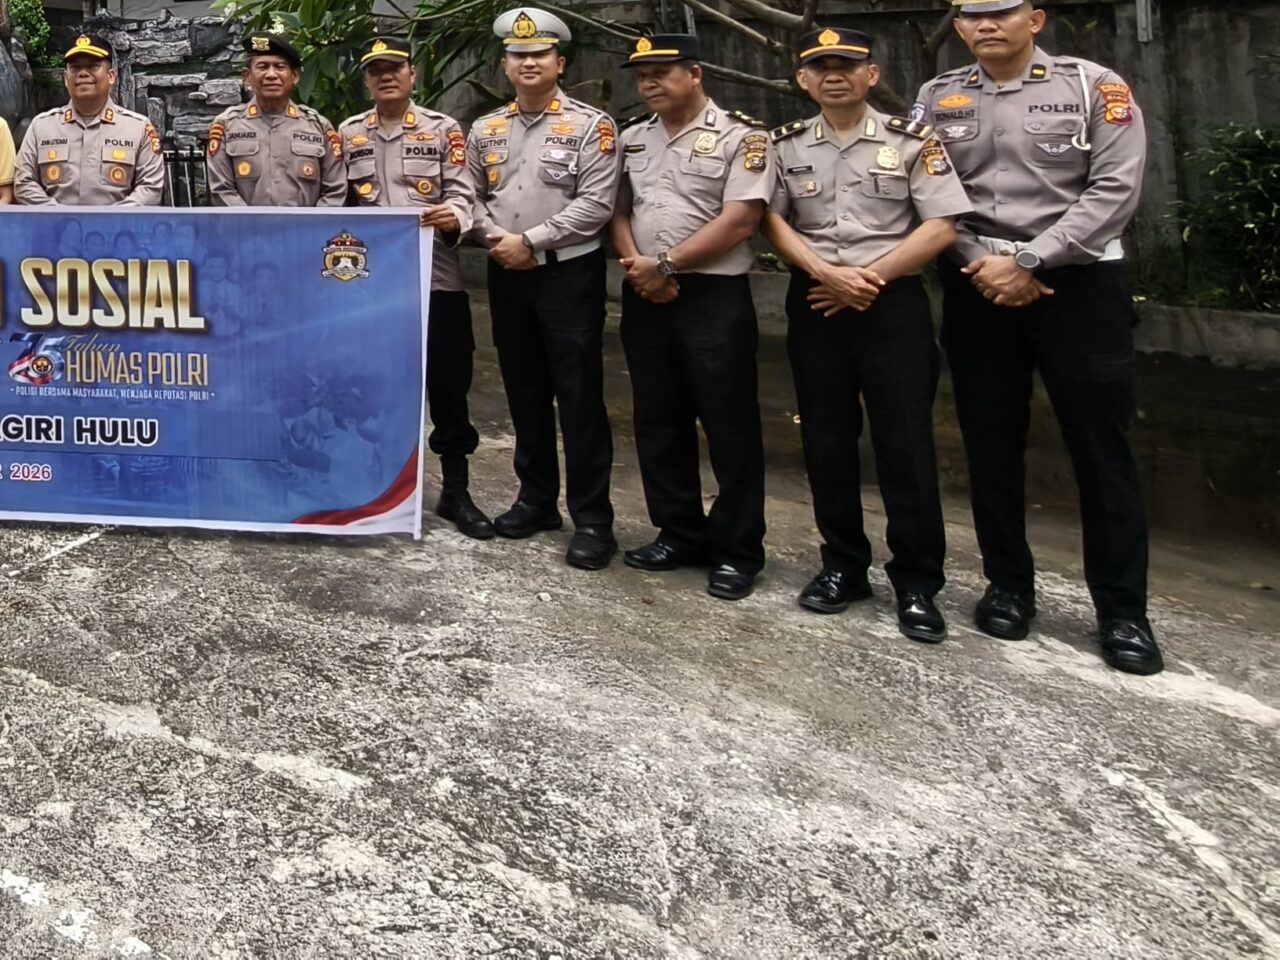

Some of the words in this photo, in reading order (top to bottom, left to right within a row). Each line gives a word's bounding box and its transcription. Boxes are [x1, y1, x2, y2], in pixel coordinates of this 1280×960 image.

[1028, 103, 1080, 114] POLRI
[104, 138, 134, 147] POLRI
[292, 132, 322, 144] POLRI
[544, 136, 578, 147] POLRI
[405, 146, 438, 156] POLRI
[20, 257, 207, 330] SOSIAL
[64, 333, 121, 353] Tahun
[66, 350, 143, 385] HUMAS
[147, 352, 209, 386] POLRI
[15, 386, 38, 396] POLISI
[39, 386, 72, 397] BERSAMA
[120, 388, 153, 399] MENJAGA
[154, 389, 188, 400] REPUTASI
[188, 390, 210, 401] POLRI
[74, 416, 159, 448] HULU
[10, 464, 53, 482] 2026
